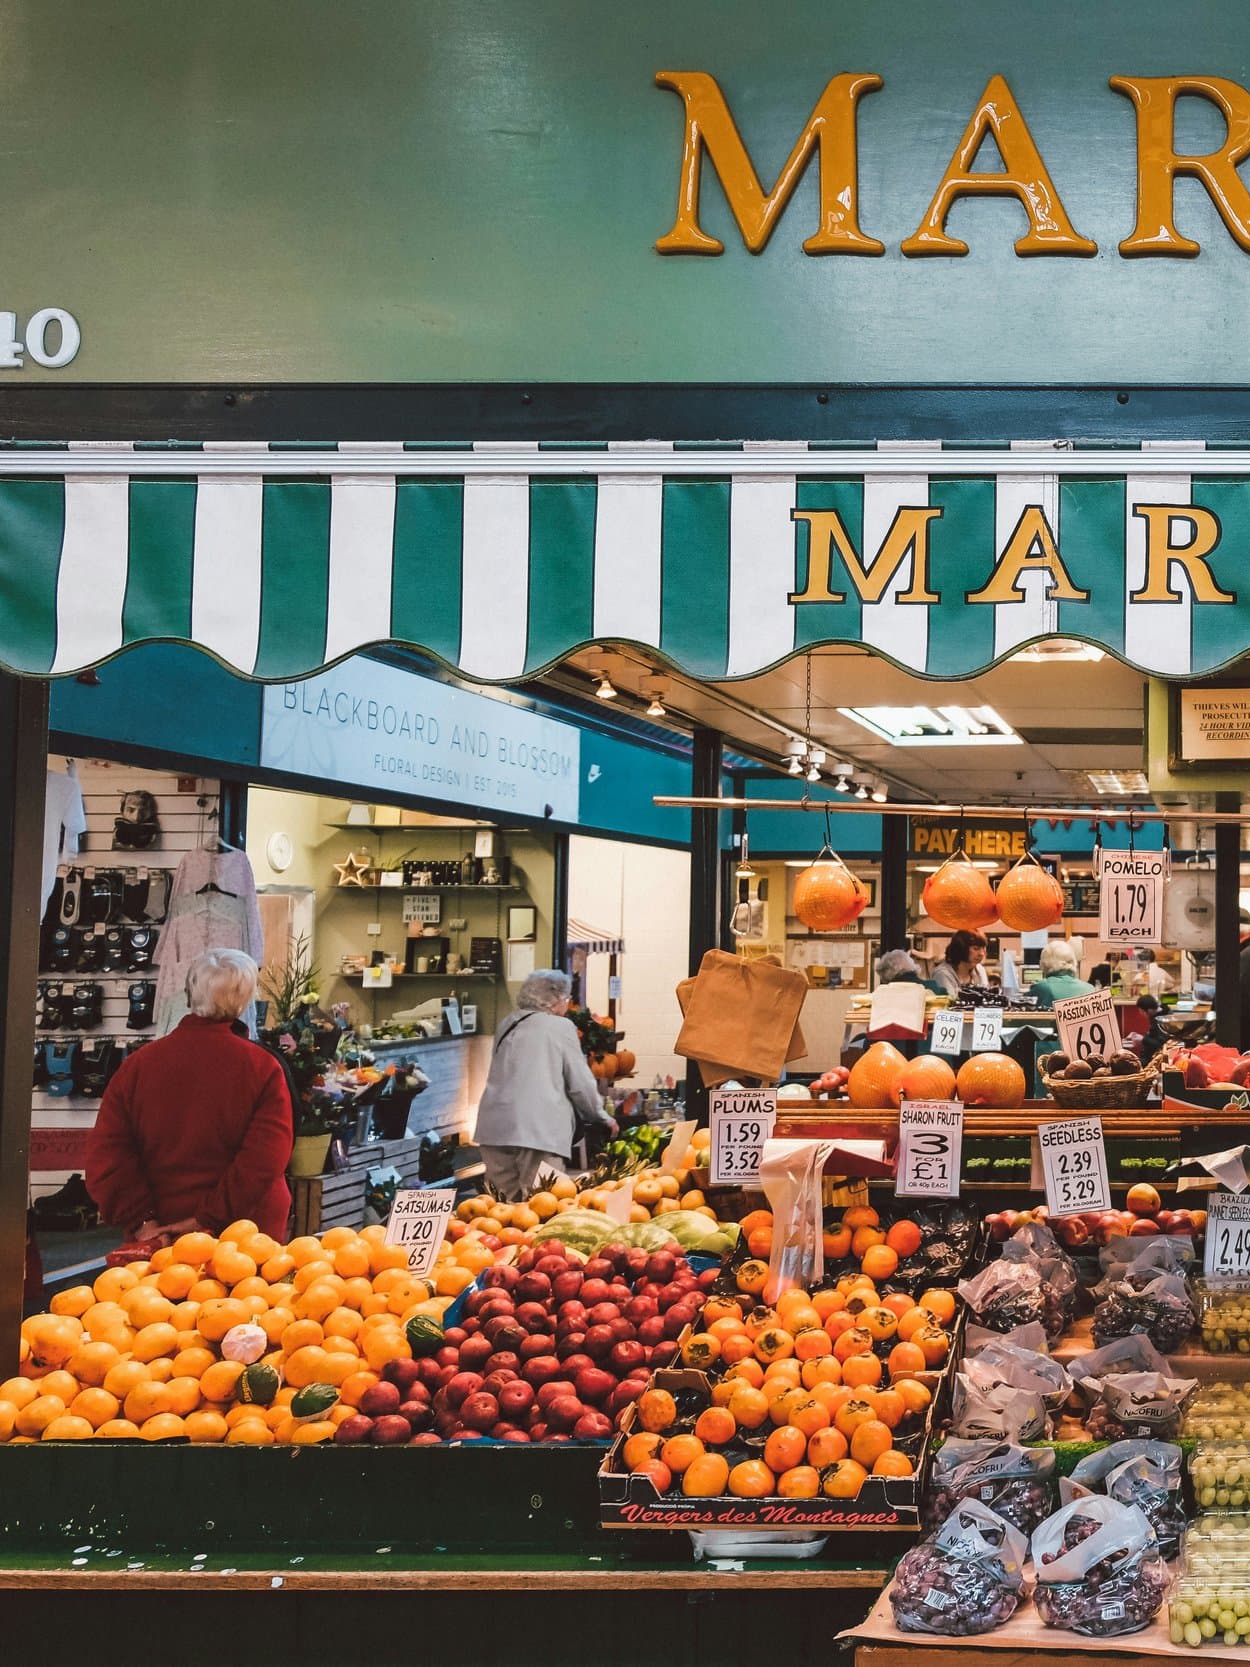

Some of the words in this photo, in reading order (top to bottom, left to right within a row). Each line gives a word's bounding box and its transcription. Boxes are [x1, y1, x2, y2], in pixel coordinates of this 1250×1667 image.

[1193, 703, 1230, 711] THIEVES
[283, 682, 440, 745] BLACKBOARD
[451, 725, 489, 758] AND
[499, 737, 571, 778] BLOSSOM
[1200, 722, 1208, 730] 24
[374, 753, 417, 779] FLORAL
[422, 763, 461, 787] DESIGN
[474, 775, 491, 792] EST
[497, 781, 517, 798] 2015
[914, 827, 958, 854] PAY
[965, 830, 1026, 855] HERE
[1104, 861, 1162, 875] POMELO
[1114, 884, 1147, 923] 1.79
[1110, 928, 1152, 936] EACH
[1058, 1004, 1091, 1021] PASSION
[1092, 998, 1112, 1015] FRUIT
[1063, 994, 1102, 1007] AFRICAN
[940, 1026, 956, 1043] 99
[980, 1023, 995, 1041] 79
[1076, 1023, 1105, 1060] 69
[713, 1100, 774, 1113] PLUMS
[902, 1111, 934, 1124] SHARON
[937, 1112, 961, 1126] FRUIT
[1048, 1121, 1090, 1131] SPANISH
[726, 1122, 760, 1142] 1.59
[1042, 1128, 1101, 1147] SEEDLESS
[910, 1133, 949, 1155] 3
[725, 1151, 759, 1170] 3.52
[1058, 1151, 1091, 1174] 2.39
[912, 1162, 948, 1180] £1
[1062, 1180, 1095, 1201] 5.29
[394, 1200, 452, 1214] SATSUMAS
[401, 1220, 433, 1241] 1.20
[408, 1247, 427, 1266] 65
[620, 1503, 713, 1528] Vergers
[717, 1506, 758, 1523] des
[760, 1506, 900, 1529] Montagnes
